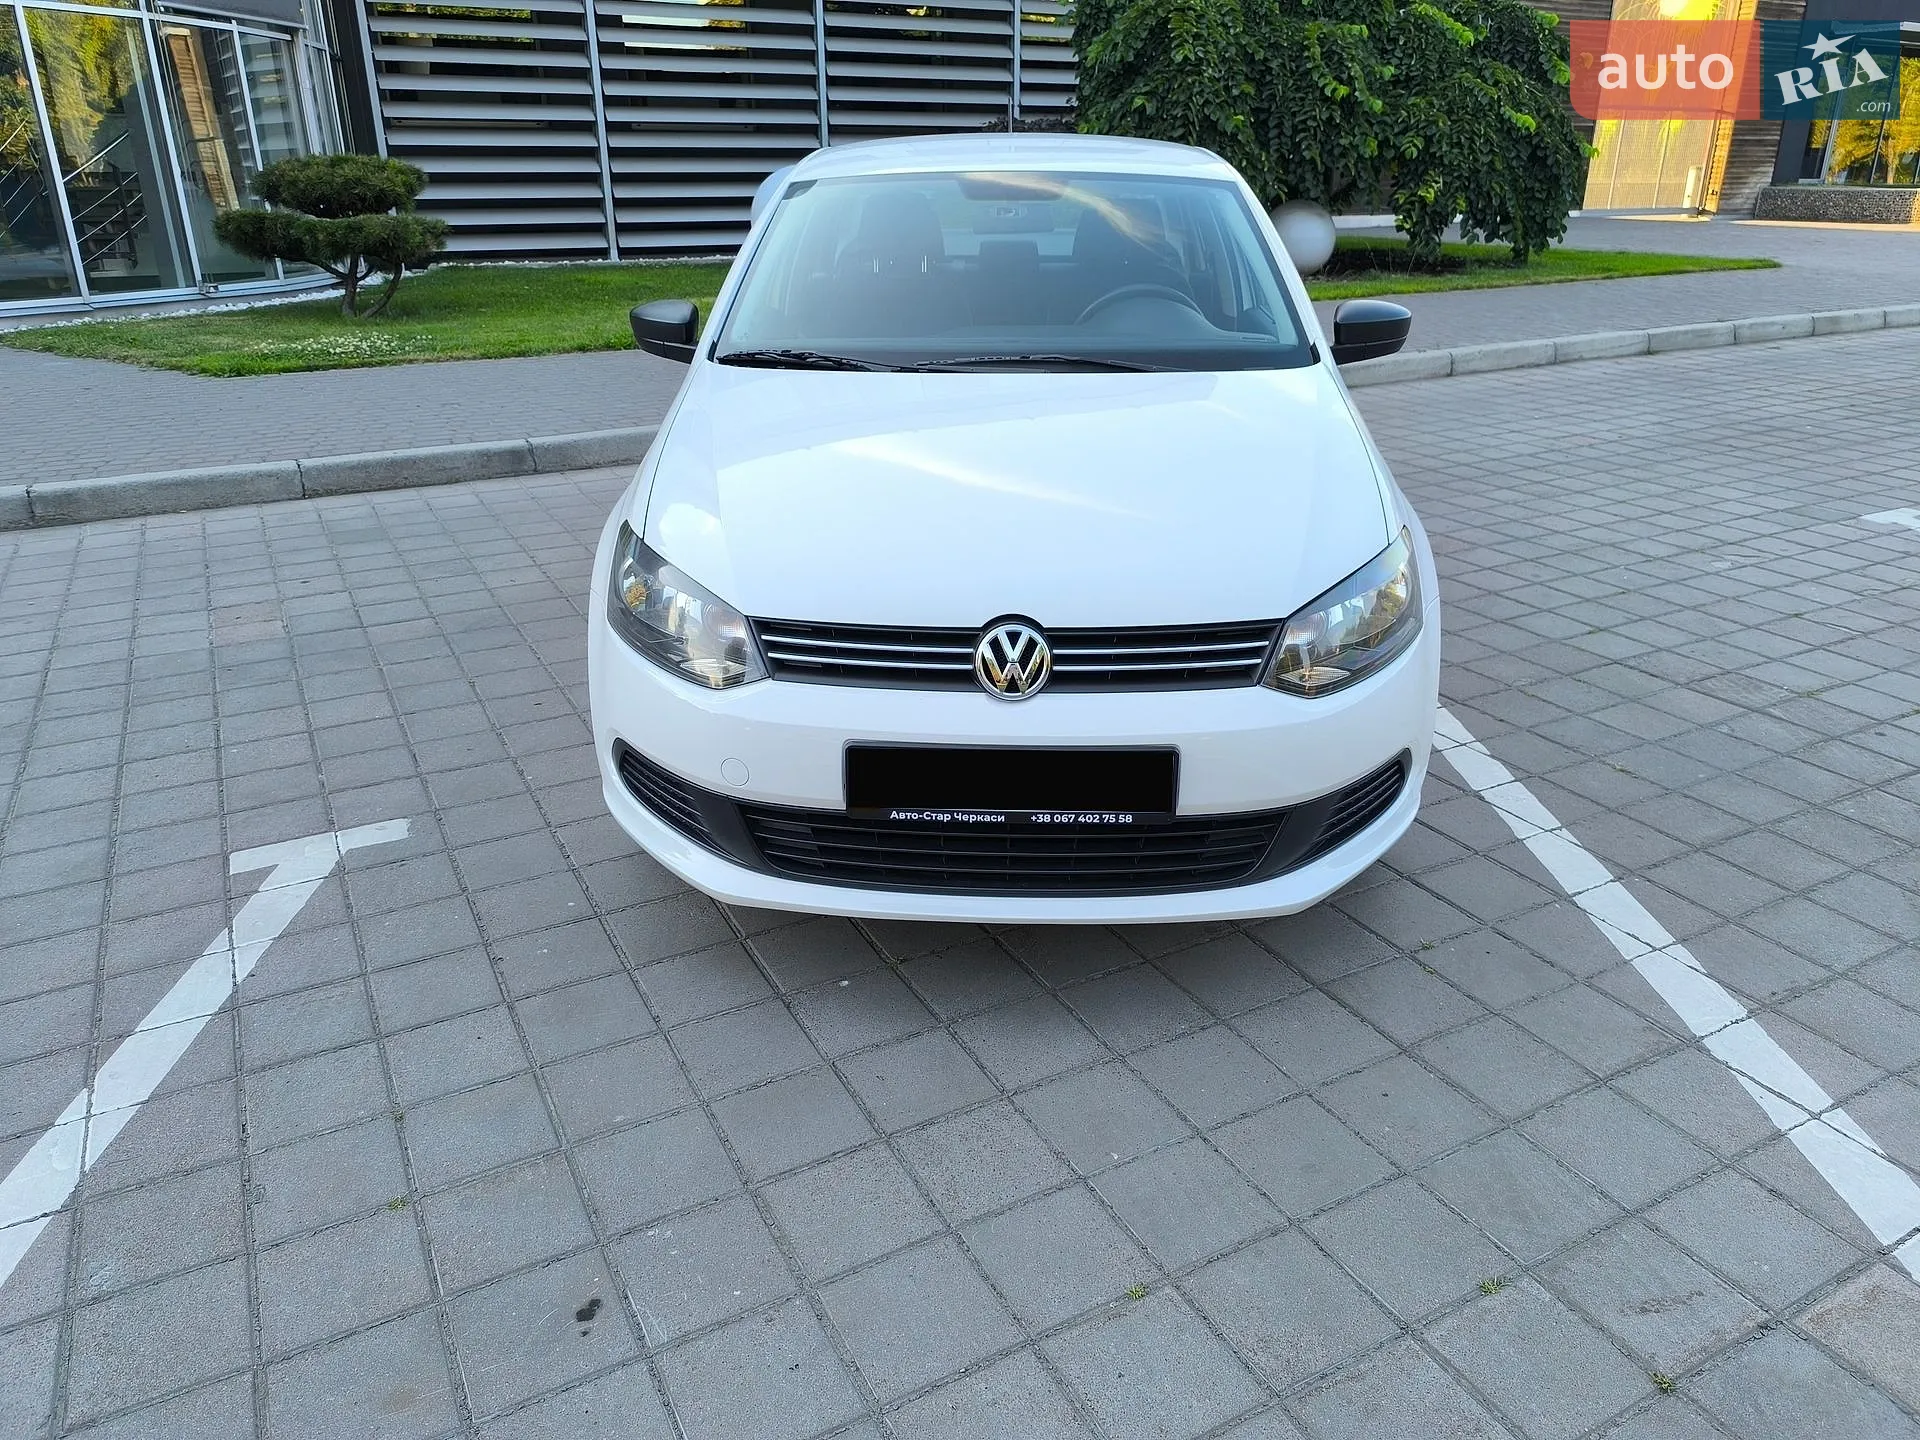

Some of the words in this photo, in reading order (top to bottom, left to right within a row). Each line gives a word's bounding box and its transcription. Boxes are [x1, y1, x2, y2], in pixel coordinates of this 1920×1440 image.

[889, 809, 952, 823] Авто-Стар
[953, 812, 1006, 824] Черкаси
[1030, 813, 1052, 824] +38
[1053, 813, 1076, 824] 067
[1077, 813, 1100, 824] 402
[1102, 813, 1116, 824] 75
[1117, 813, 1133, 824] 58
